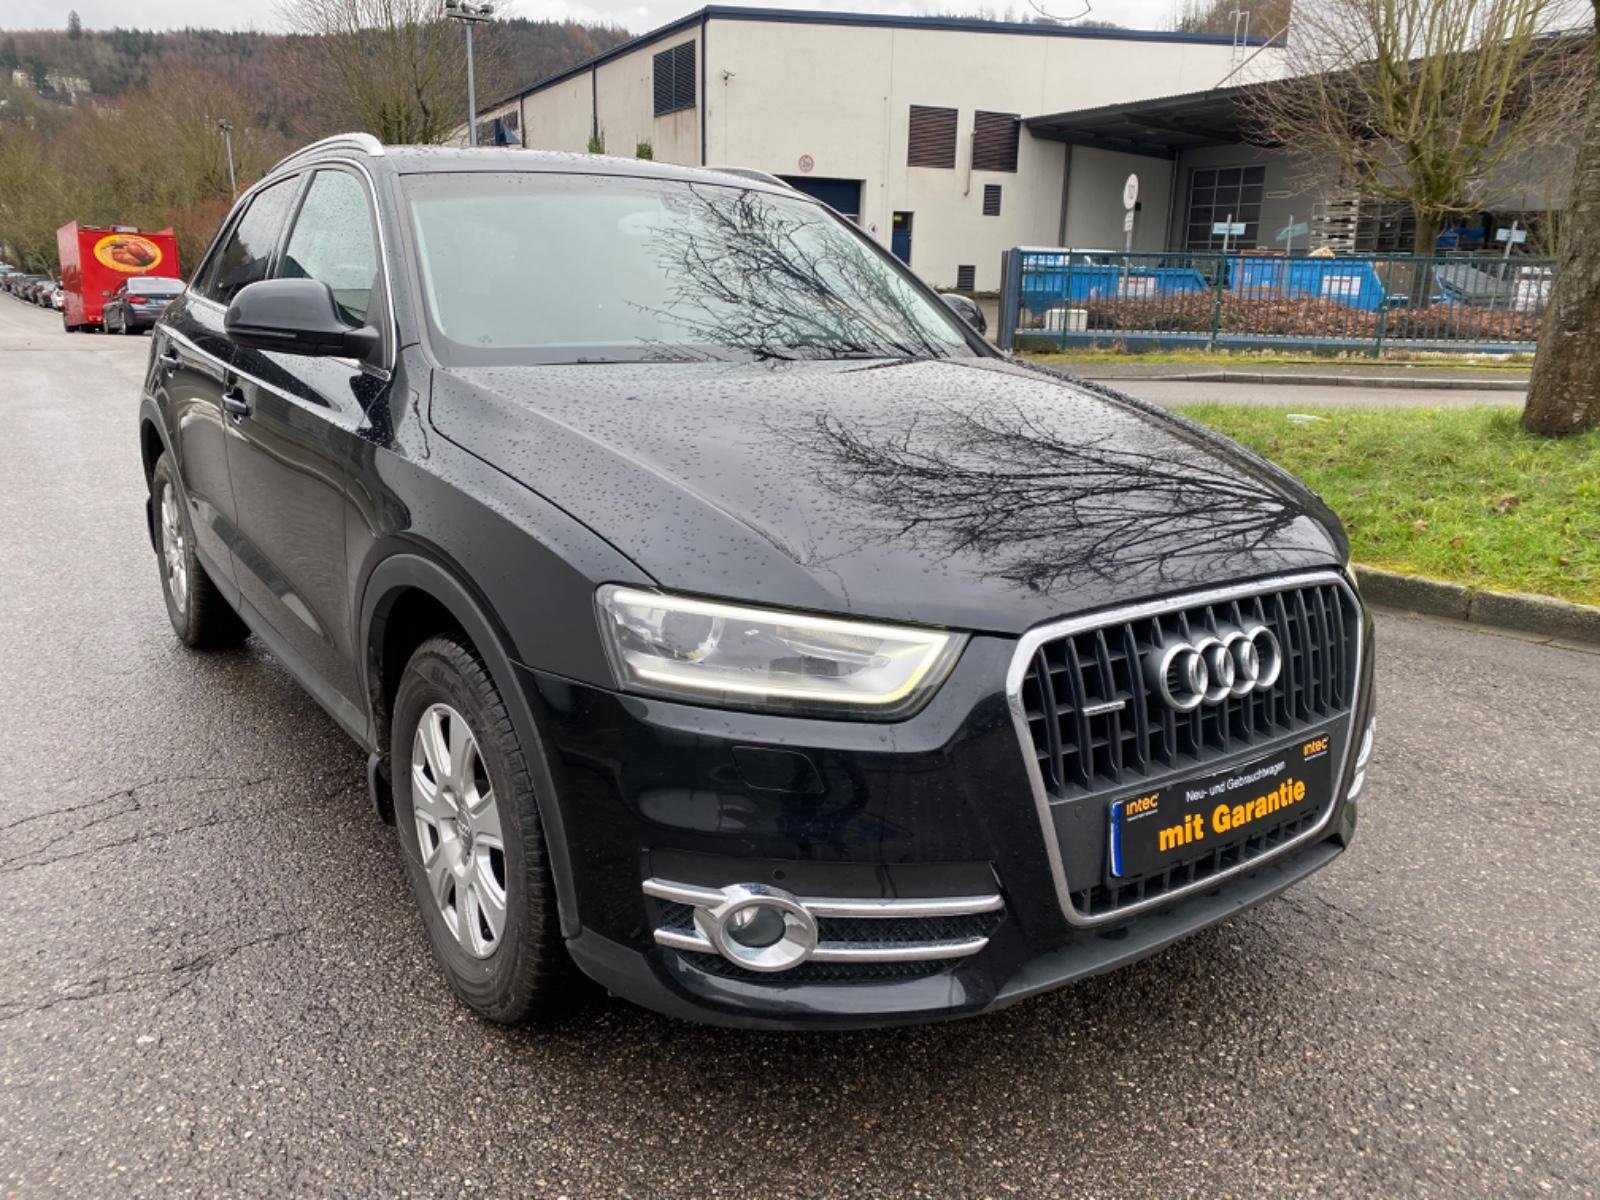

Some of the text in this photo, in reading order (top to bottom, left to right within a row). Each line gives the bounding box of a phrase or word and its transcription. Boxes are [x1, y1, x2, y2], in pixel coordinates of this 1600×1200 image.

[1209, 781, 1226, 796] und
[1226, 760, 1286, 790] Gebrauchtwagen
[1126, 793, 1158, 816] intec
[1159, 777, 1306, 852] mit Garantie
